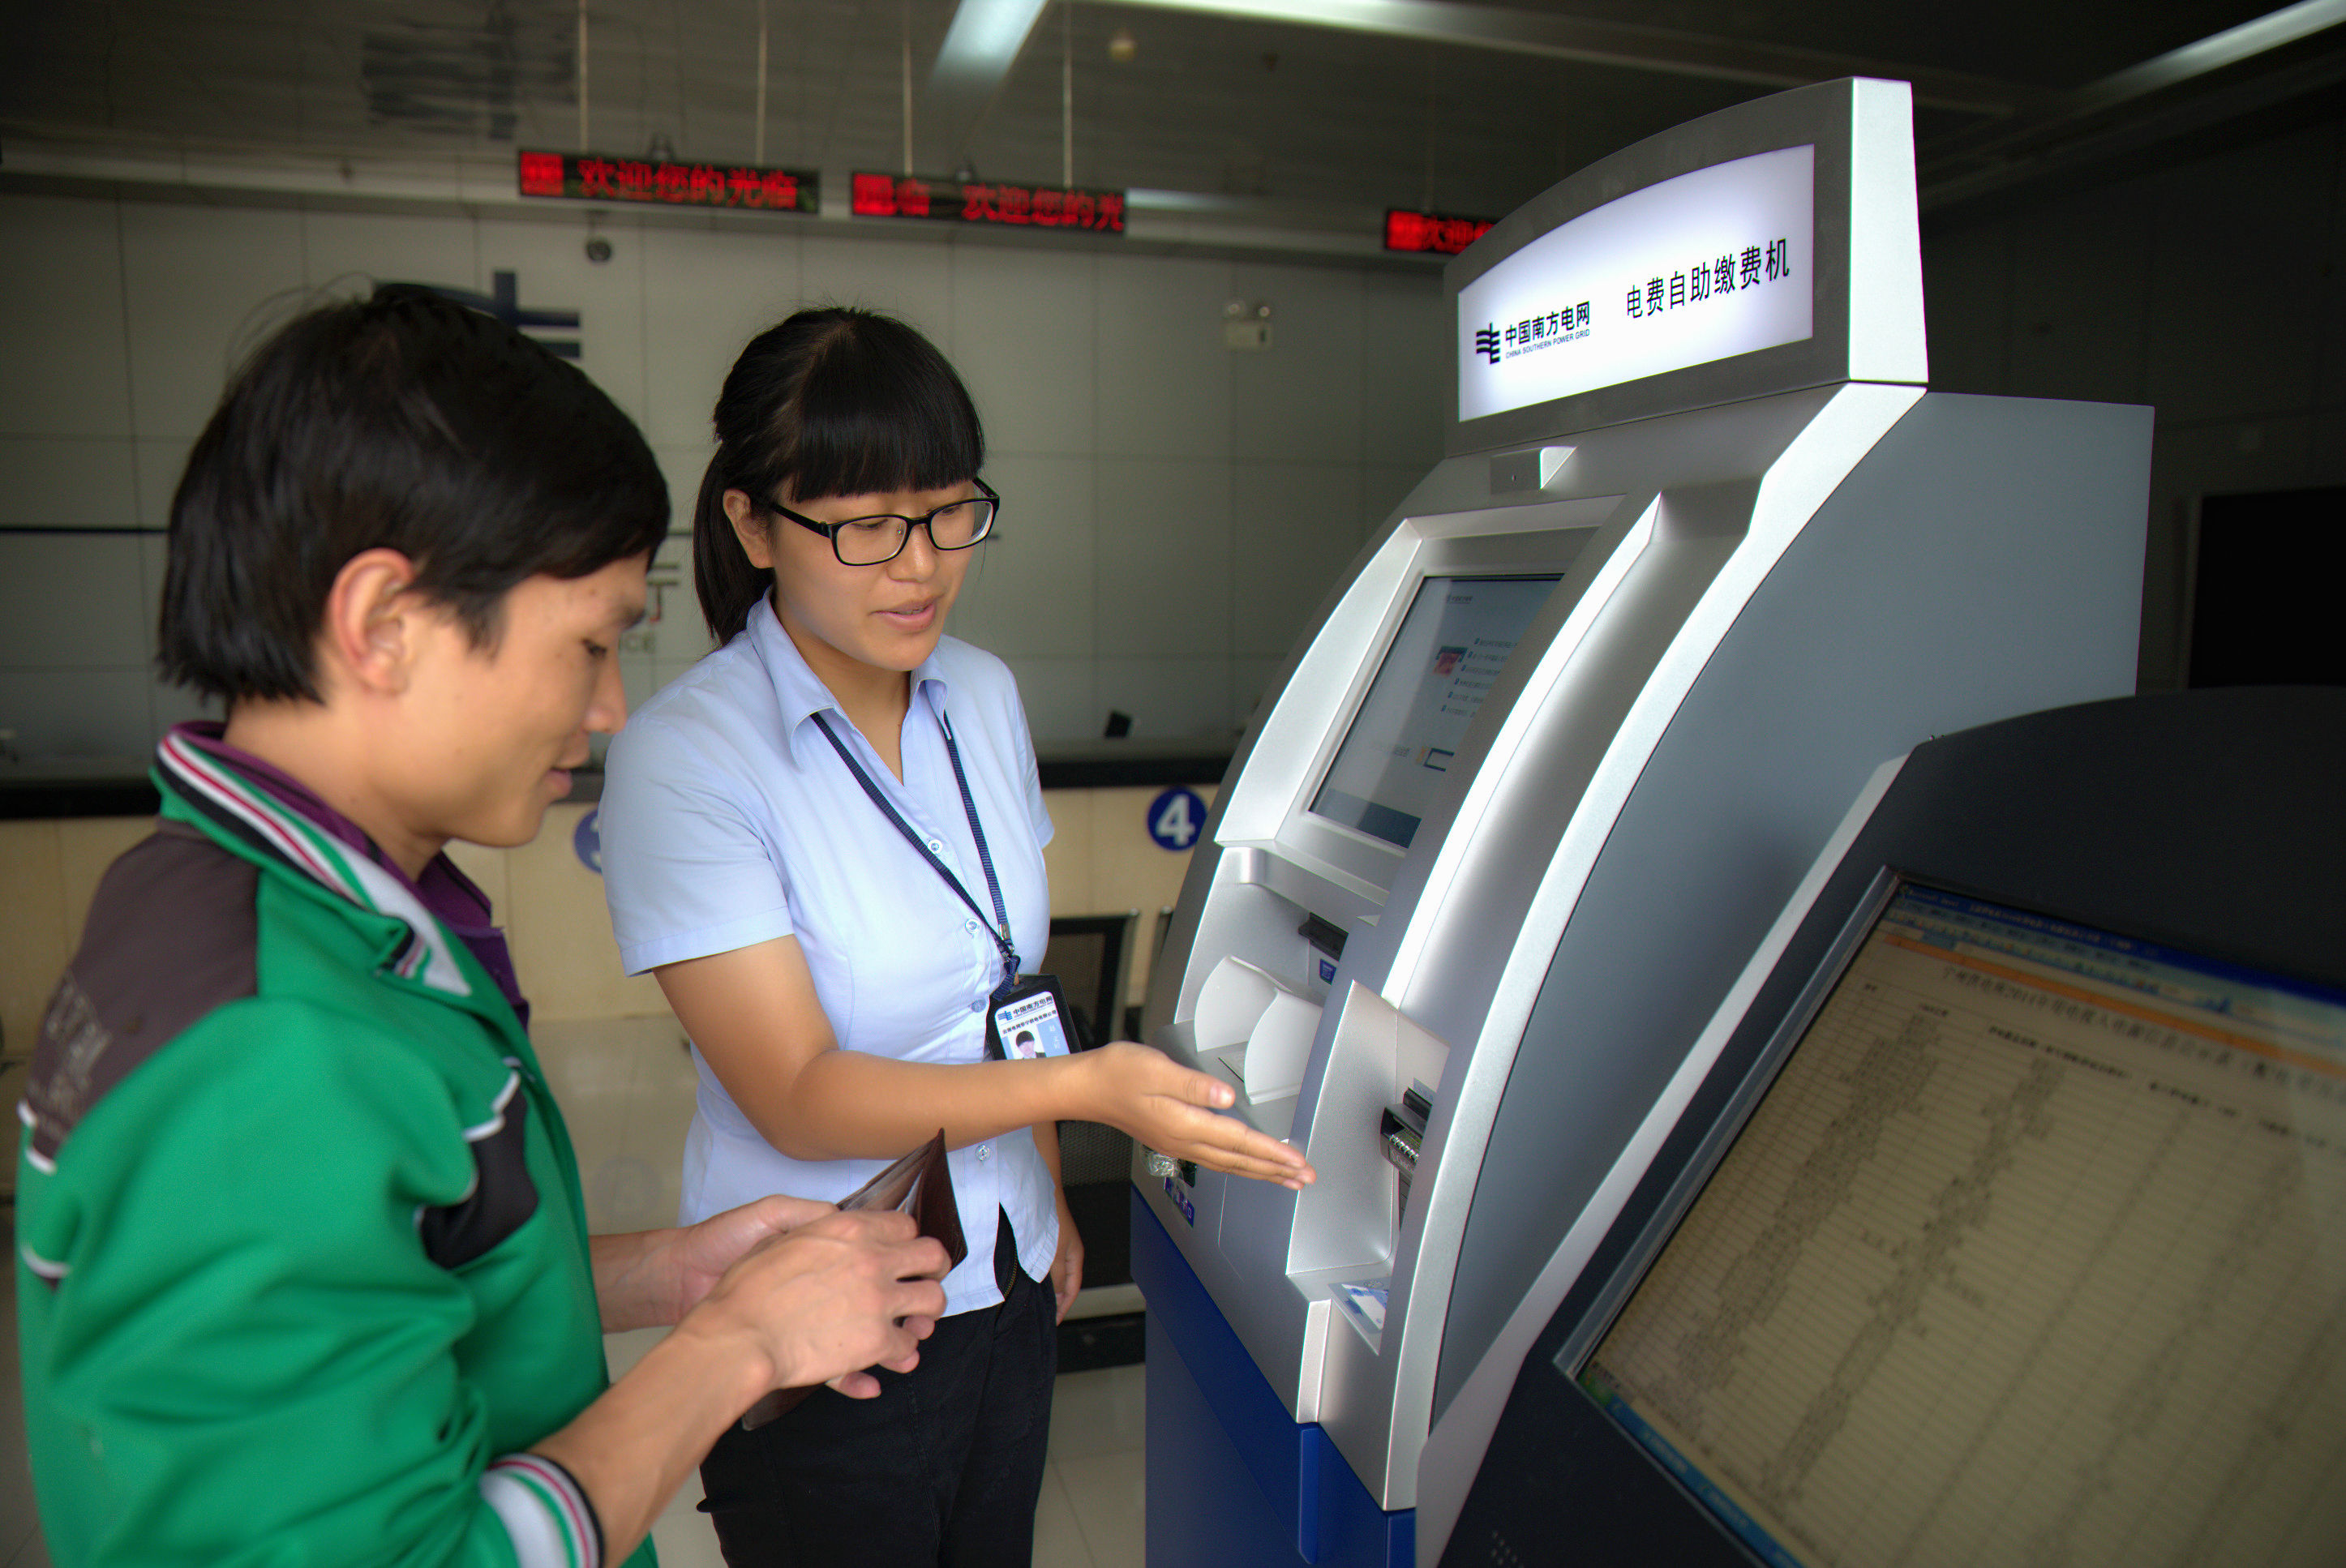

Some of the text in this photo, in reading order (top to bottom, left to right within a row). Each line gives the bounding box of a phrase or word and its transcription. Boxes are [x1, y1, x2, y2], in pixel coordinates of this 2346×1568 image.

[577, 156, 798, 209] 欢迎您的光临
[961, 182, 1125, 232] 欢迎您的光
[1627, 238, 1791, 319] 电费自助缴费机
[1505, 300, 1590, 348] 中国南方电网
[1506, 328, 1590, 359] CHINA SOUTHERN POWER GRID
[1156, 794, 1196, 846] 4
[1013, 996, 1053, 1015] 中国南方电网
